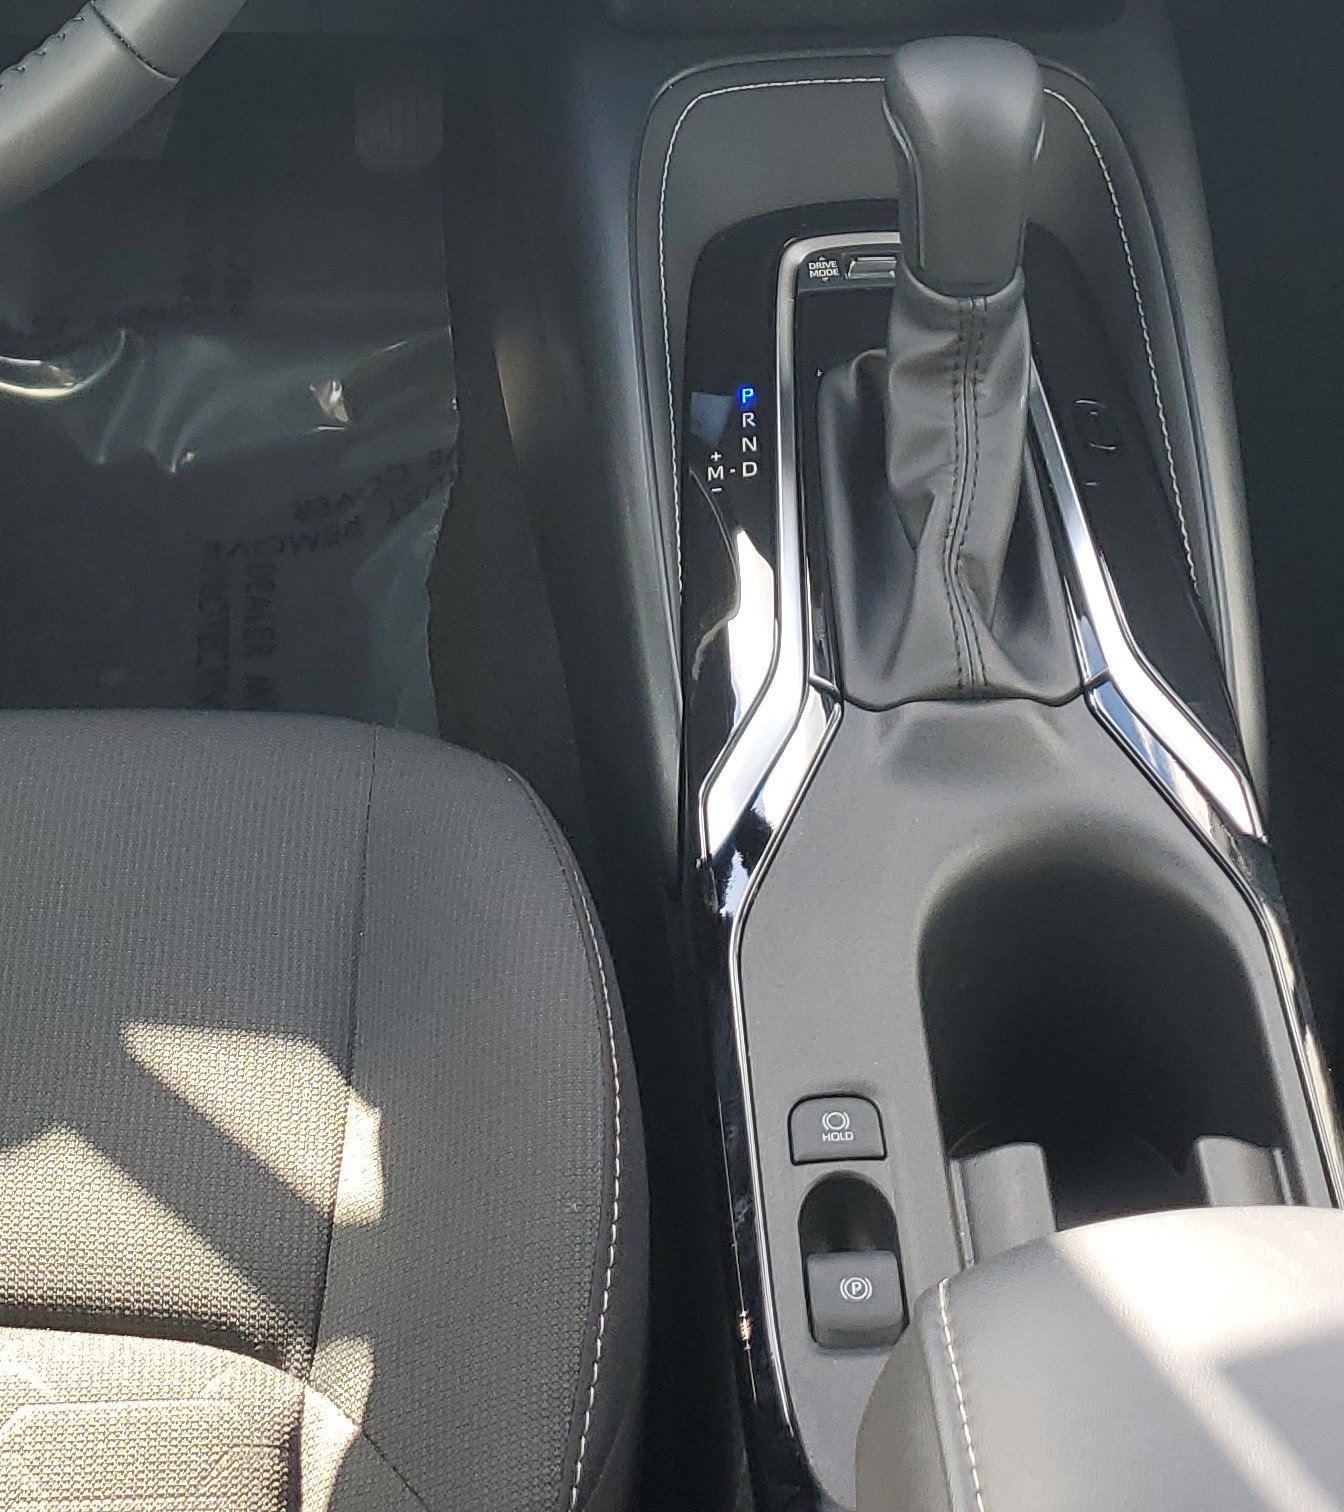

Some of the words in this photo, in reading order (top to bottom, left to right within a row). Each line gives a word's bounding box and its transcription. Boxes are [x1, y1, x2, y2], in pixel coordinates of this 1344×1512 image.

[809, 260, 838, 270] DRIVE
[809, 268, 840, 278] MODE
[741, 388, 754, 404] P
[742, 412, 756, 428] R
[742, 437, 758, 452] N
[708, 465, 724, 481] M
[742, 462, 758, 477] D
[822, 1131, 854, 1142] HOLD
